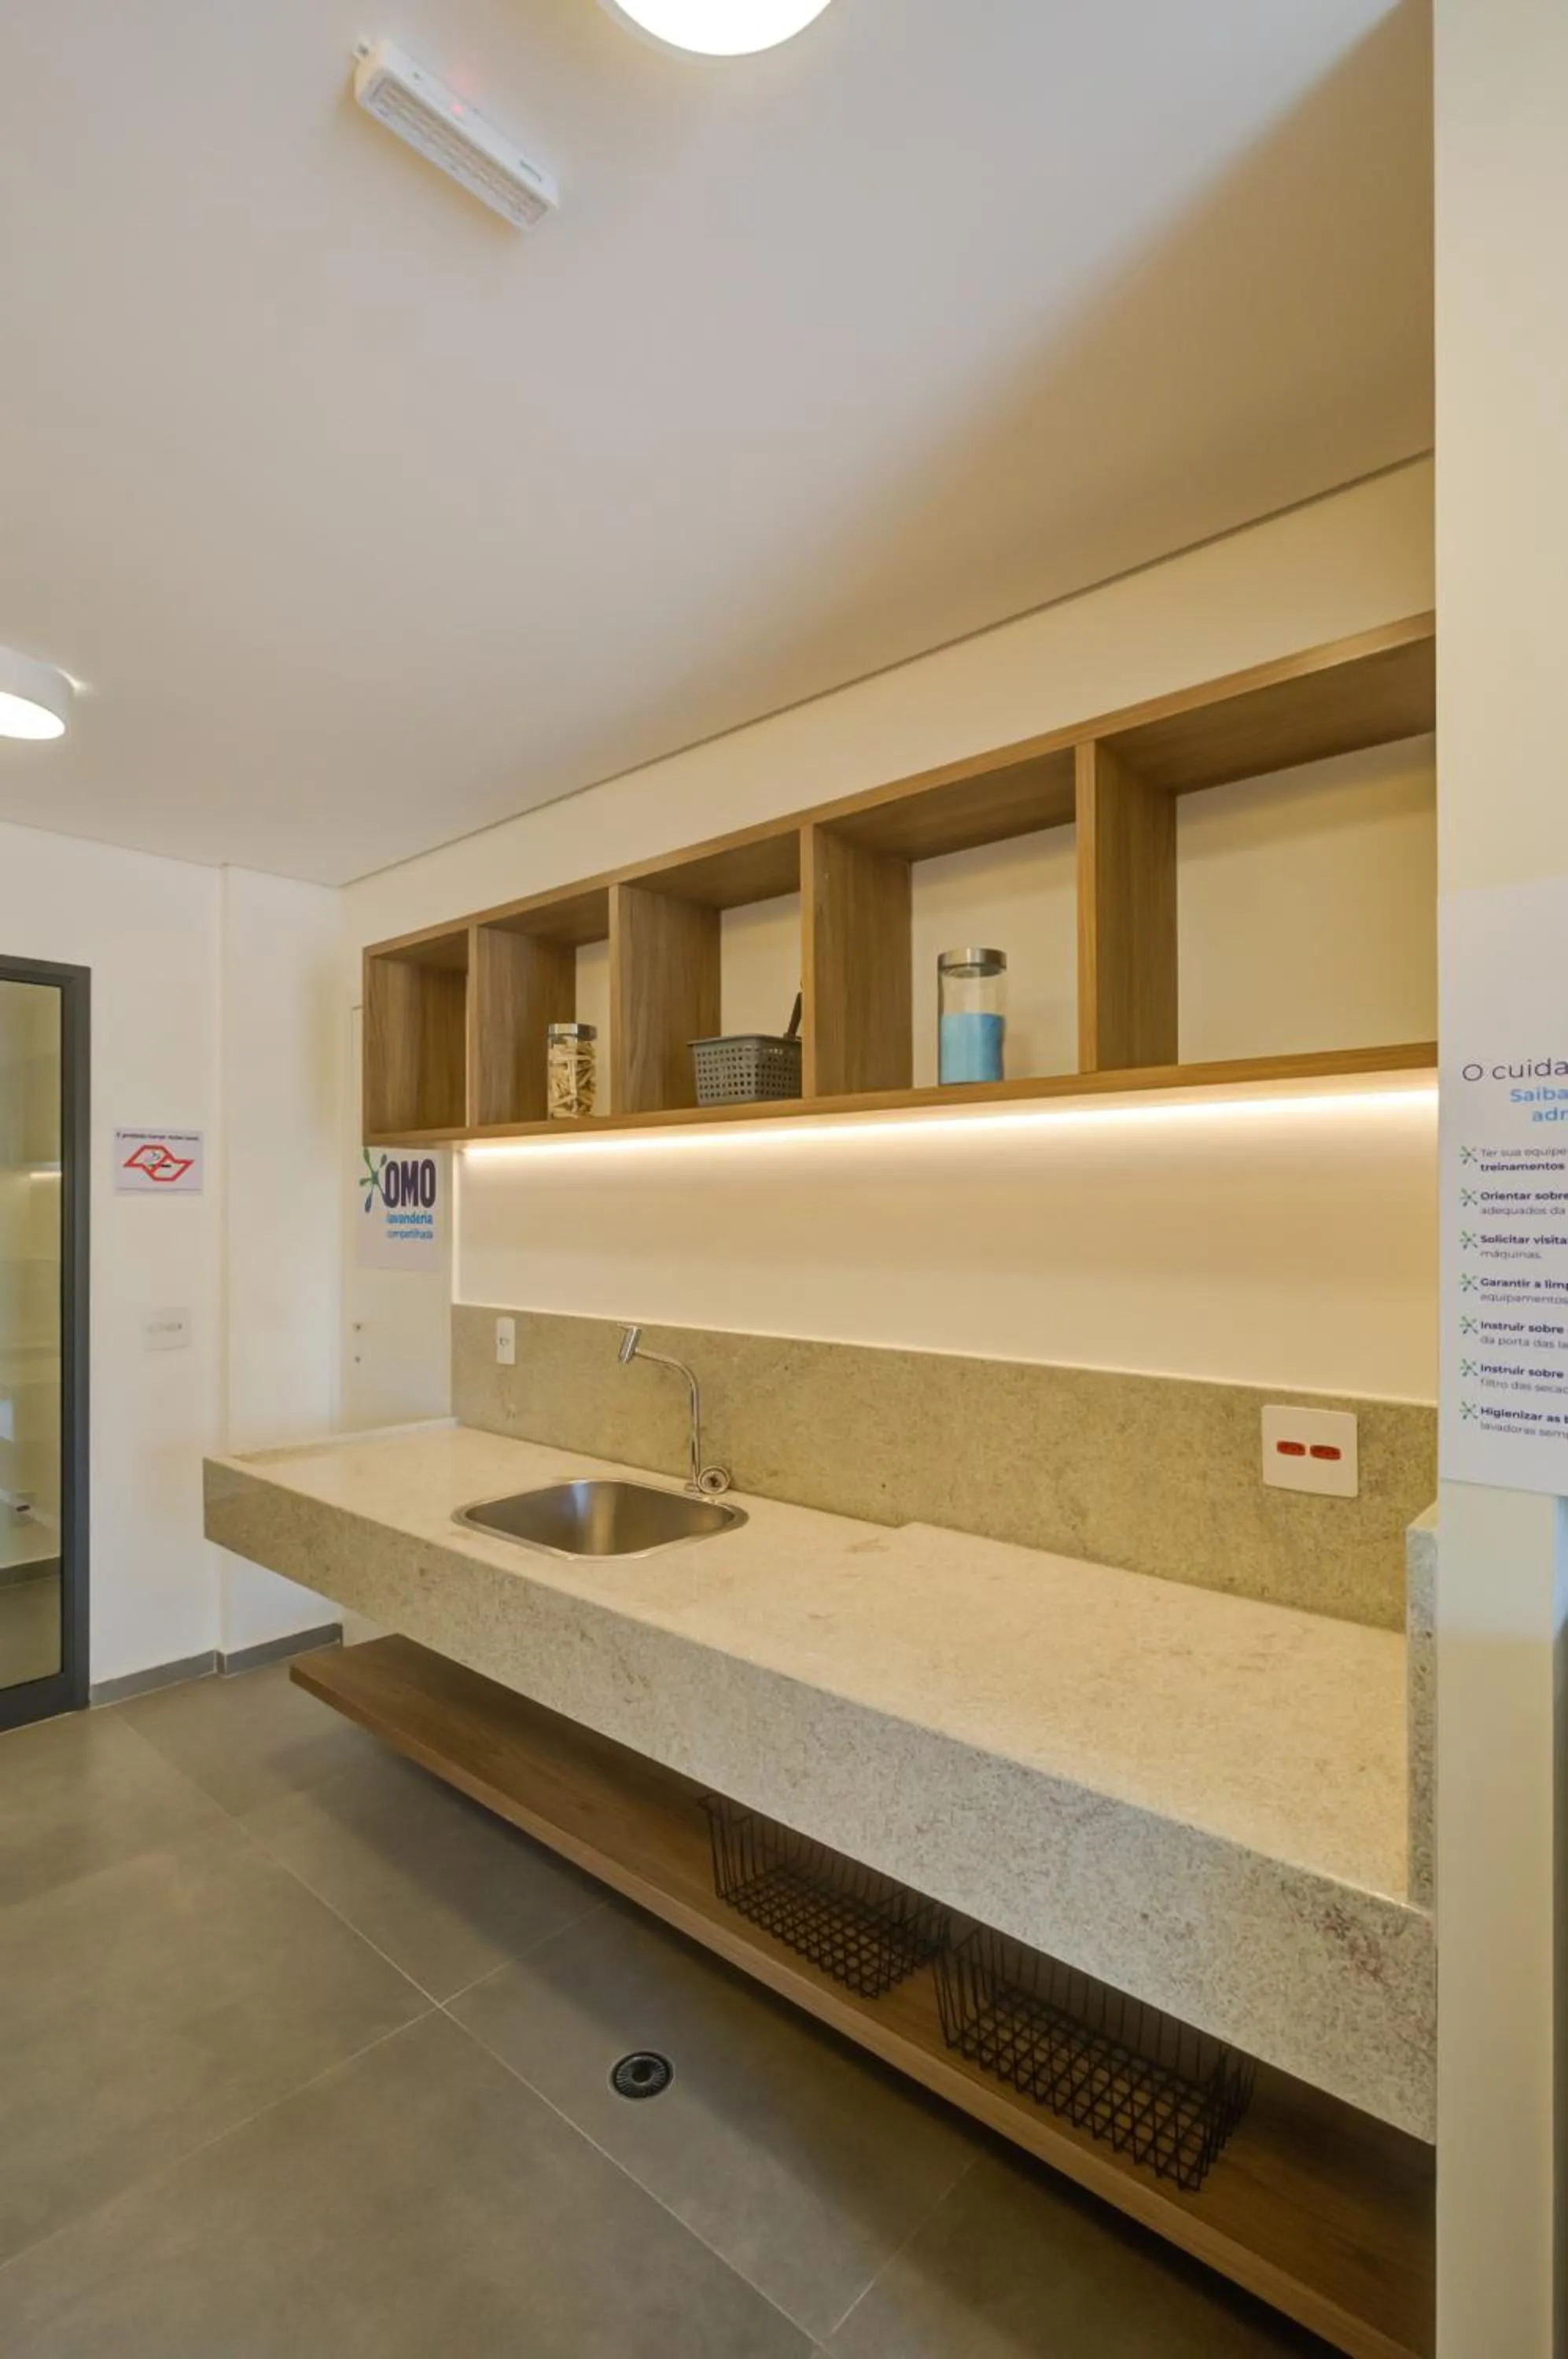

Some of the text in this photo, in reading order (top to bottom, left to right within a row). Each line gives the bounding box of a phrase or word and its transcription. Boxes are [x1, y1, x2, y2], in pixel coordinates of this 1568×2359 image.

[1462, 1057, 1568, 1082] O cuida
[1509, 1087, 1568, 1102] Saiba
[1481, 1148, 1567, 1158] Ter sua equipe
[1480, 1162, 1565, 1172] treinamentos
[385, 1158, 436, 1209] OMO
[1480, 1191, 1568, 1201] Orientar sobre
[1482, 1206, 1566, 1216] adequados da
[1480, 1235, 1530, 1244] Solicitar
[1480, 1278, 1531, 1288] Garantir
[1481, 1321, 1565, 1334] Instruir sobre
[1480, 1336, 1495, 1345] da
[1497, 1337, 1530, 1347] porta
[1533, 1339, 1555, 1349] das
[1481, 1364, 1565, 1379] Instruir sobre
[1481, 1406, 1543, 1421] Higienizar
[1547, 1415, 1561, 1423] as
